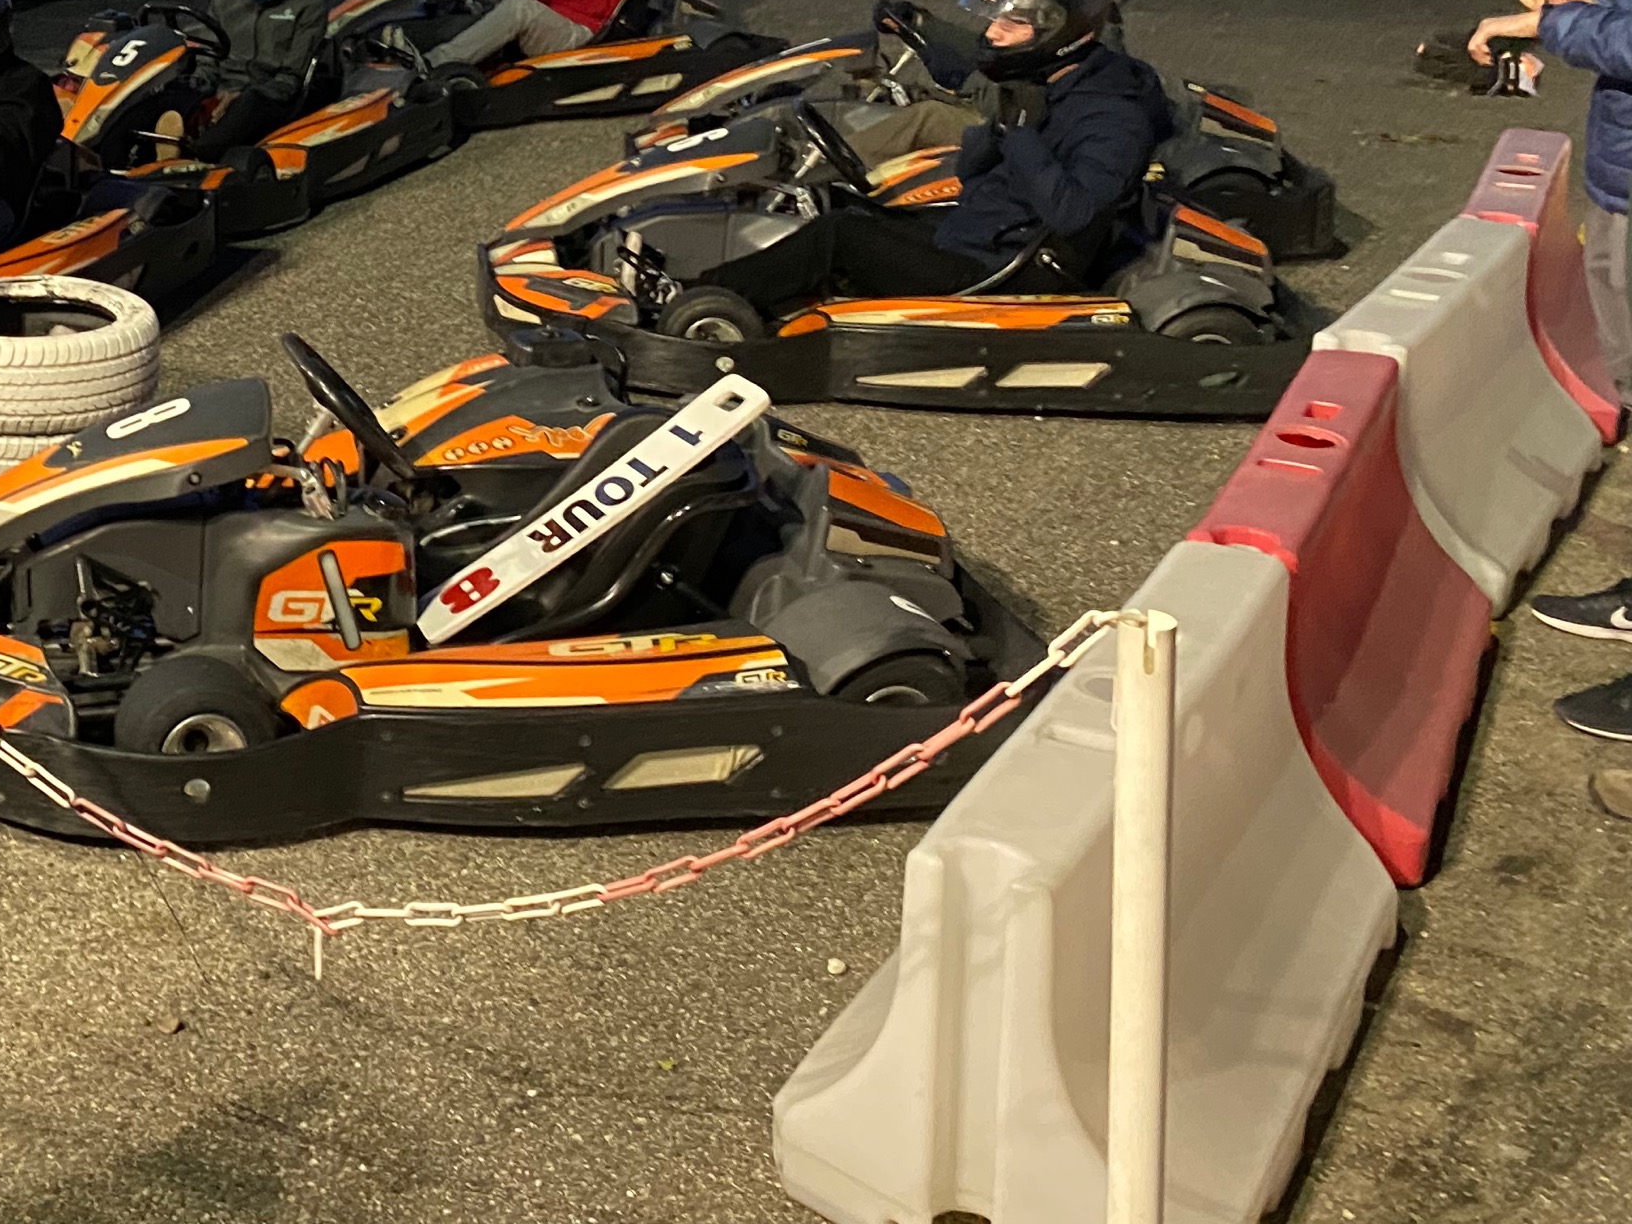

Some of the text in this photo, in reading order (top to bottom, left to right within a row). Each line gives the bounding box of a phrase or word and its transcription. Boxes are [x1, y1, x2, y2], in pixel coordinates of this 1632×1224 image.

[111, 40, 148, 67] 5
[106, 398, 191, 439] 8
[668, 424, 704, 447] 1
[527, 457, 669, 554] TOUR
[439, 566, 500, 615] 8
